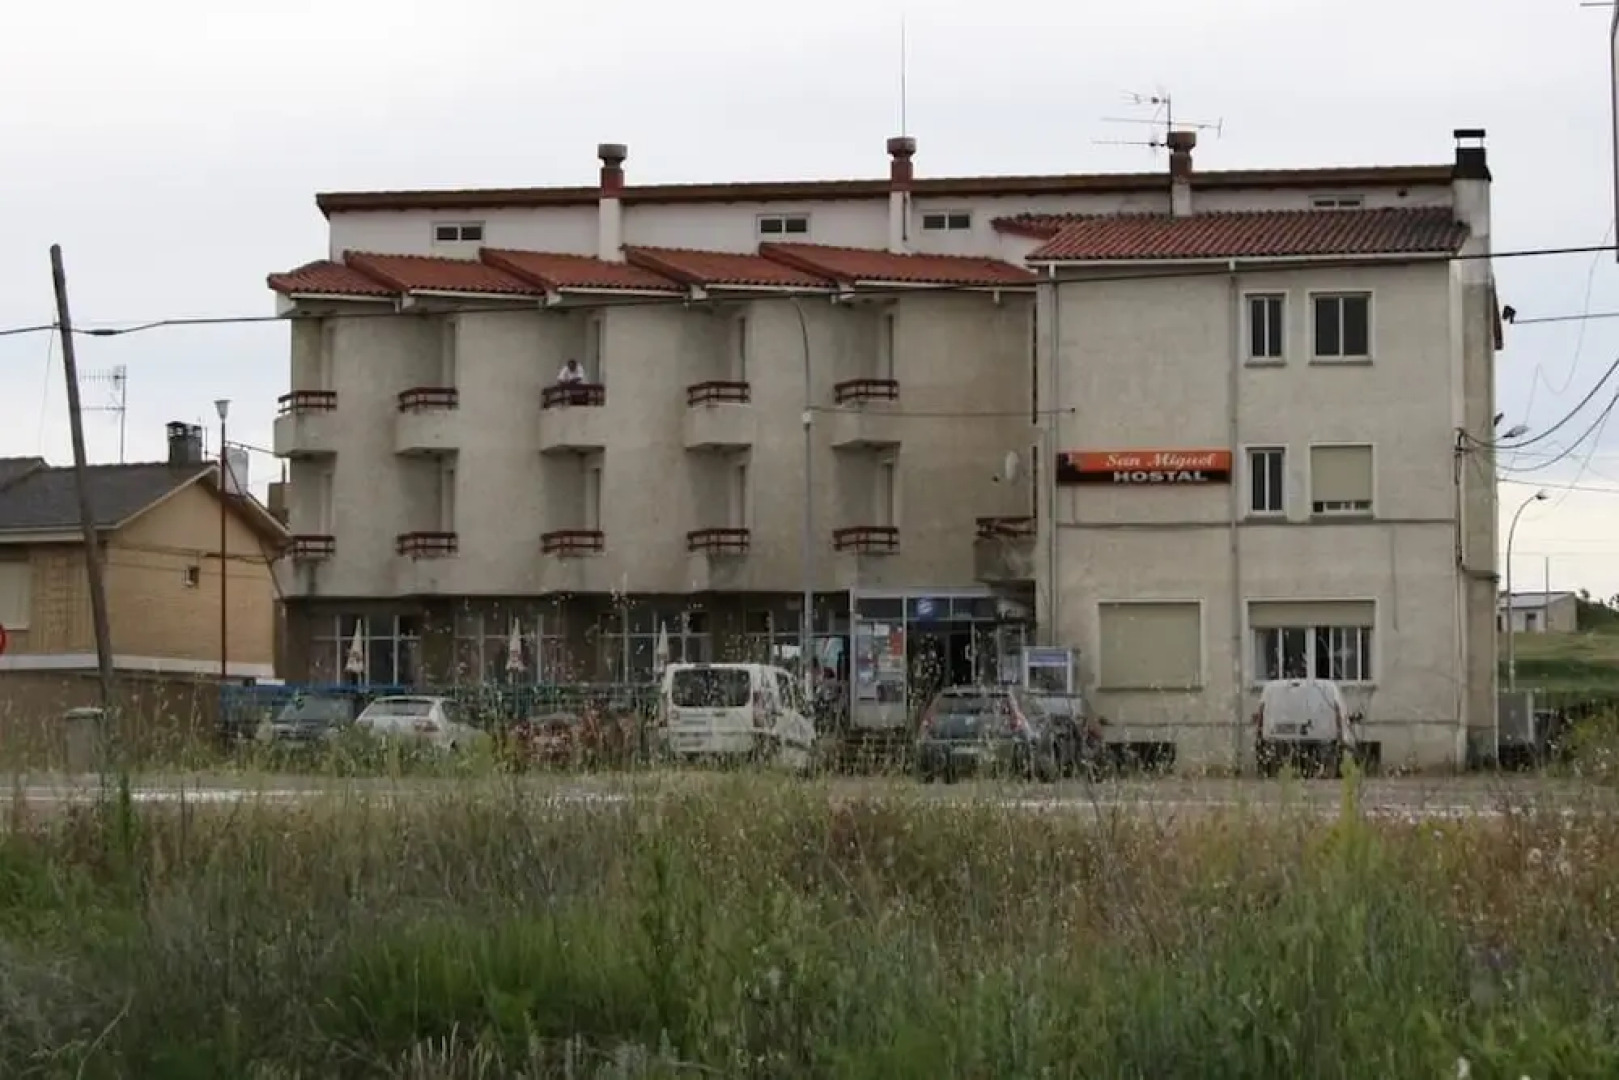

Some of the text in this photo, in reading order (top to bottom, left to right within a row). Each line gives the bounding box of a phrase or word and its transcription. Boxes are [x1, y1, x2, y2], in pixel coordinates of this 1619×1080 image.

[1106, 453, 1217, 470] San Miguel
[1113, 471, 1208, 482] HOSTAL
